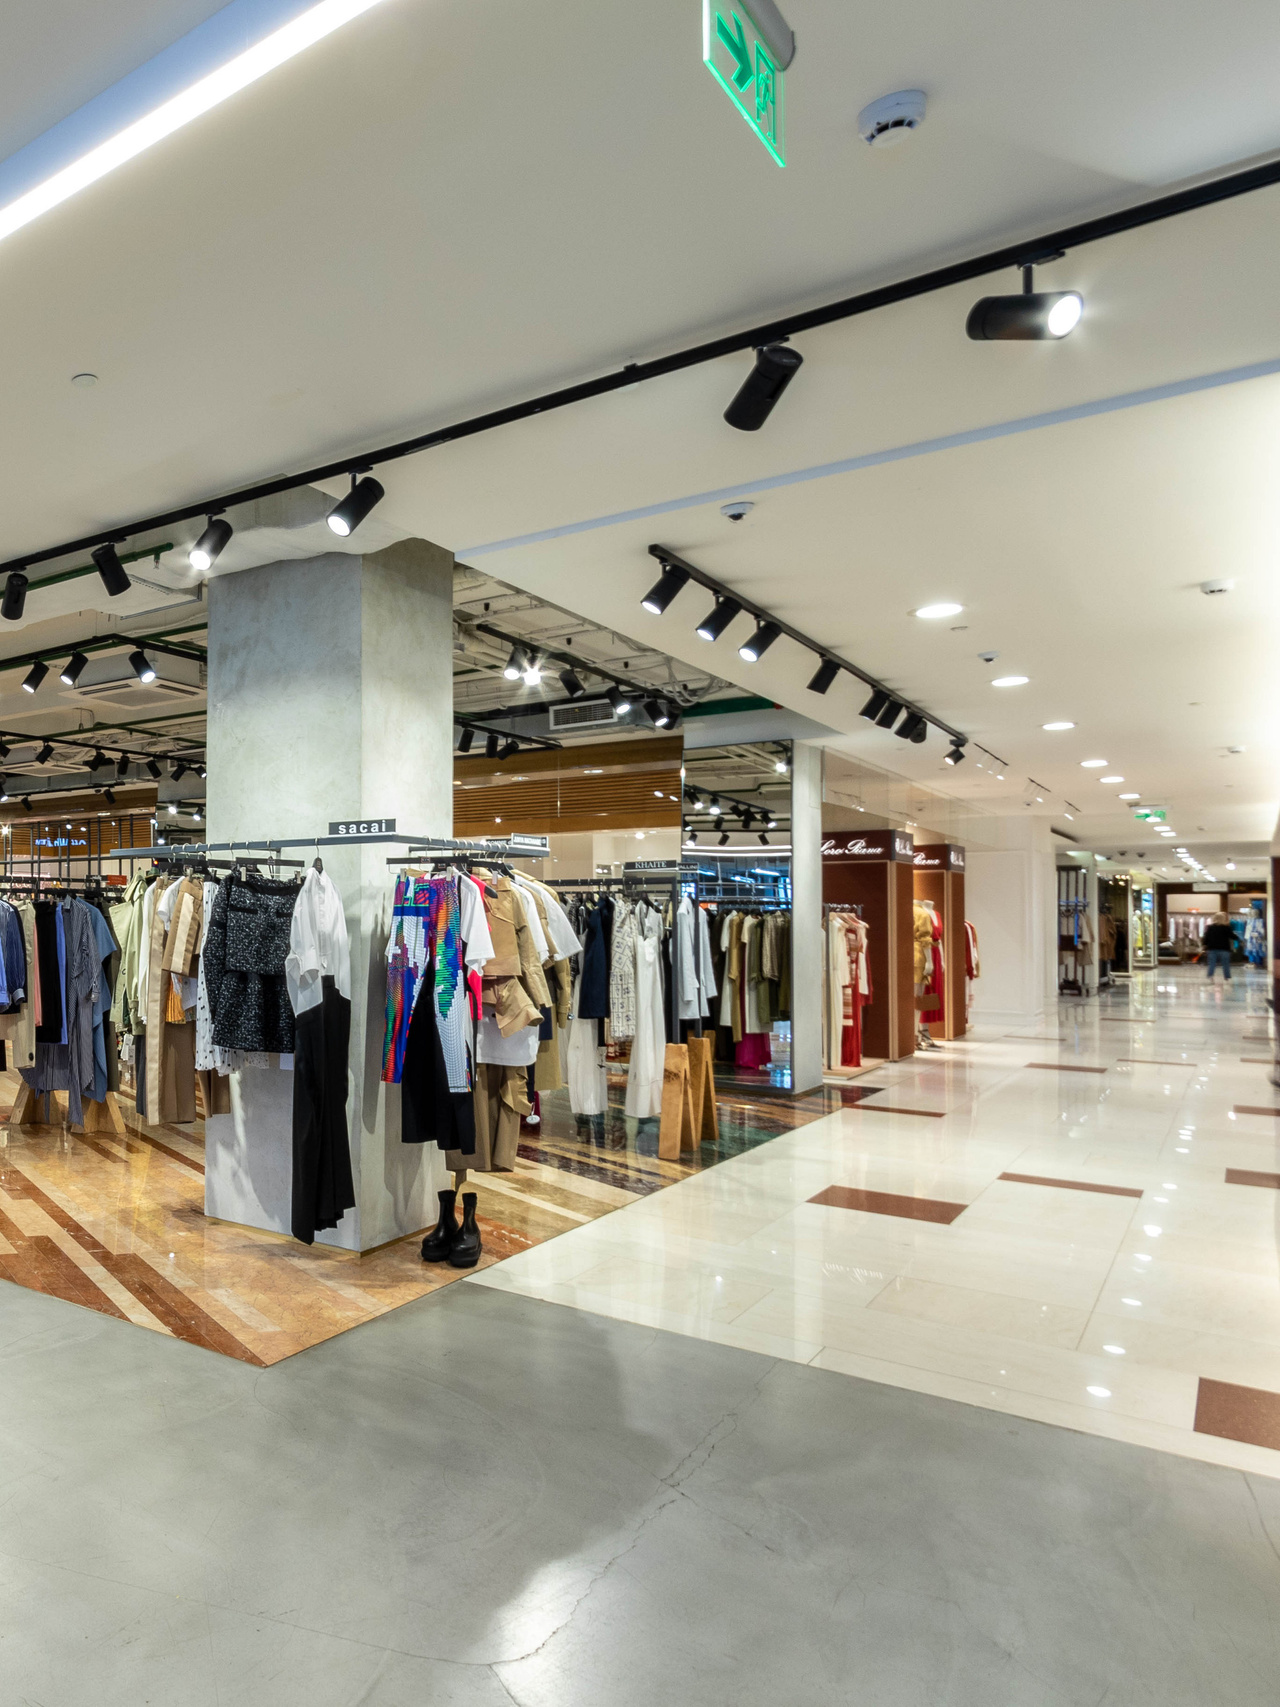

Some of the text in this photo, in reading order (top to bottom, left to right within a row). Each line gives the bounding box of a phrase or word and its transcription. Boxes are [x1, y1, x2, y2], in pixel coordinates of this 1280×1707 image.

[338, 820, 386, 834] sacai
[845, 838, 884, 855] Piana
[635, 861, 667, 869] KHAITE
